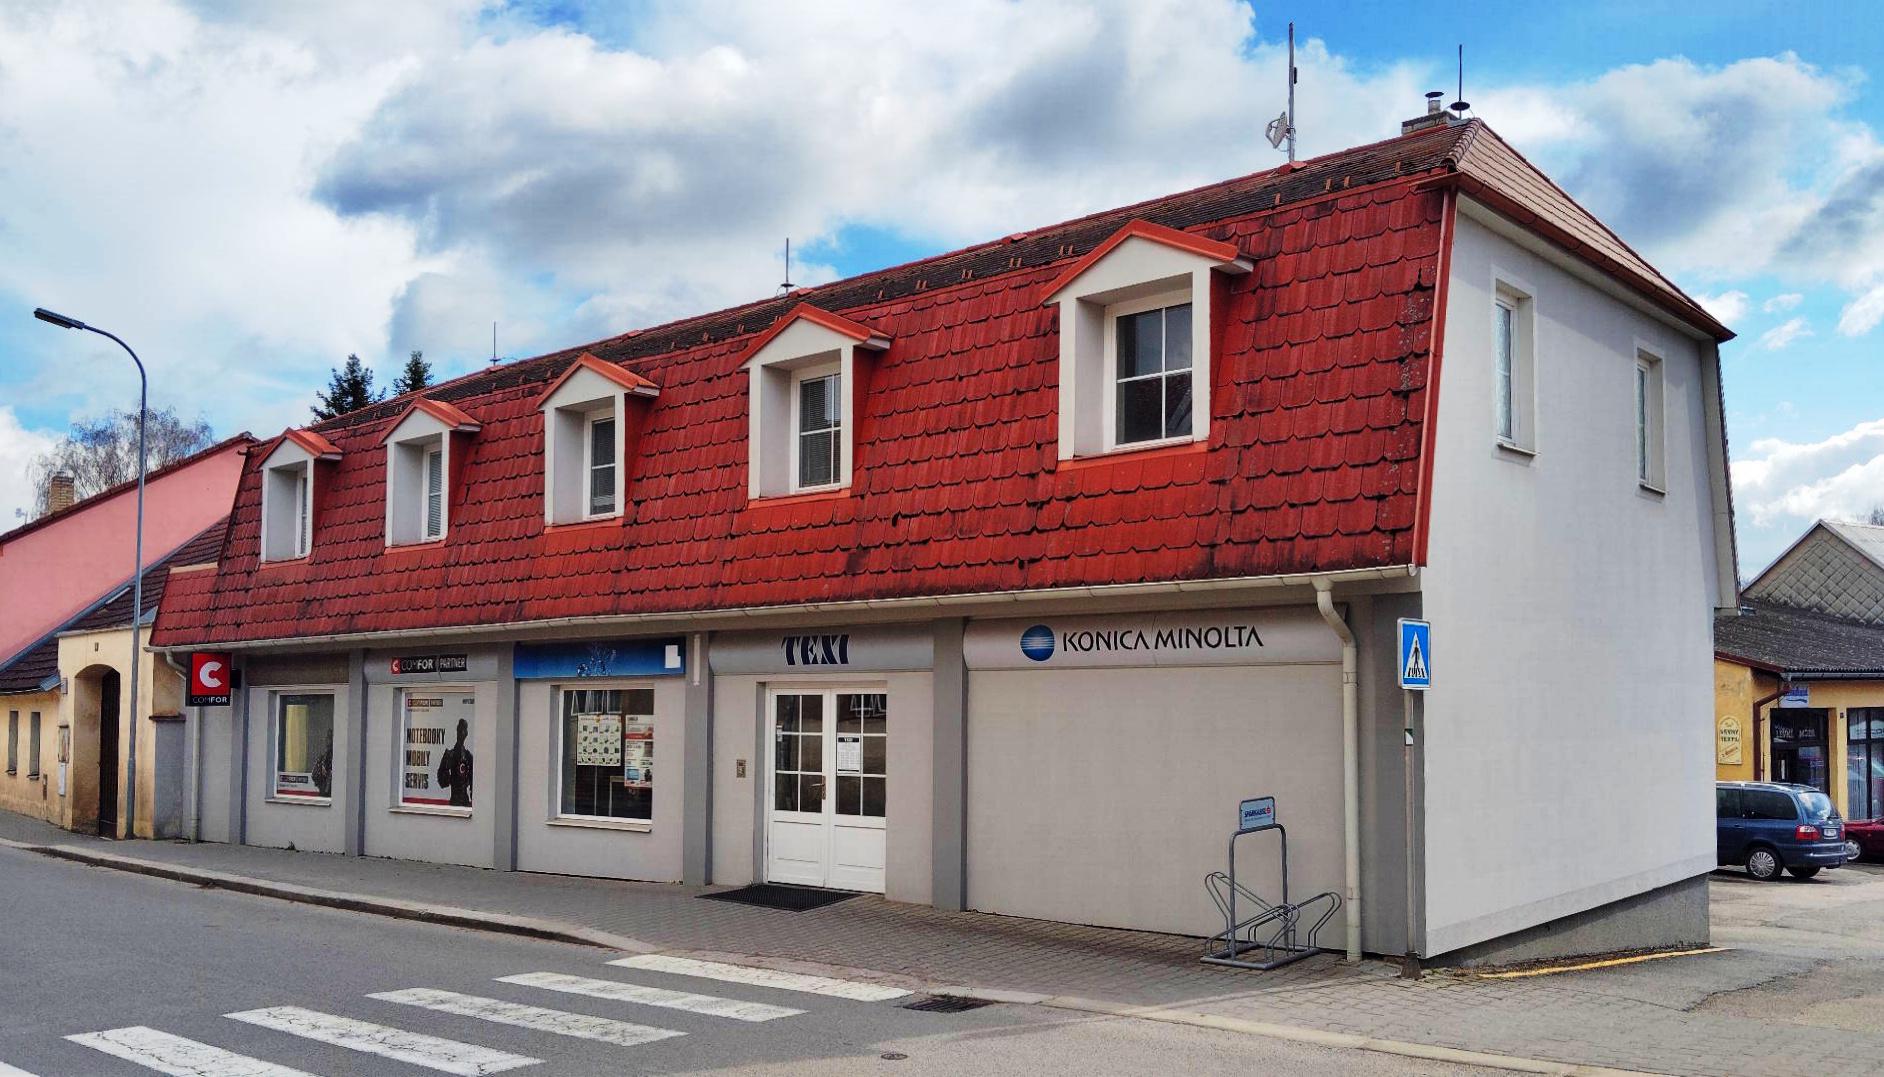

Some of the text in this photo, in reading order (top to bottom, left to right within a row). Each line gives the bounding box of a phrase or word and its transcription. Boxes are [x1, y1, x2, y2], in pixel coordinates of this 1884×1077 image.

[1063, 625, 1265, 652] KONICA MINOLTA
[192, 696, 228, 704] COMFOR
[406, 728, 446, 745] NOTEBOOKY
[404, 773, 429, 790] SERVIS
